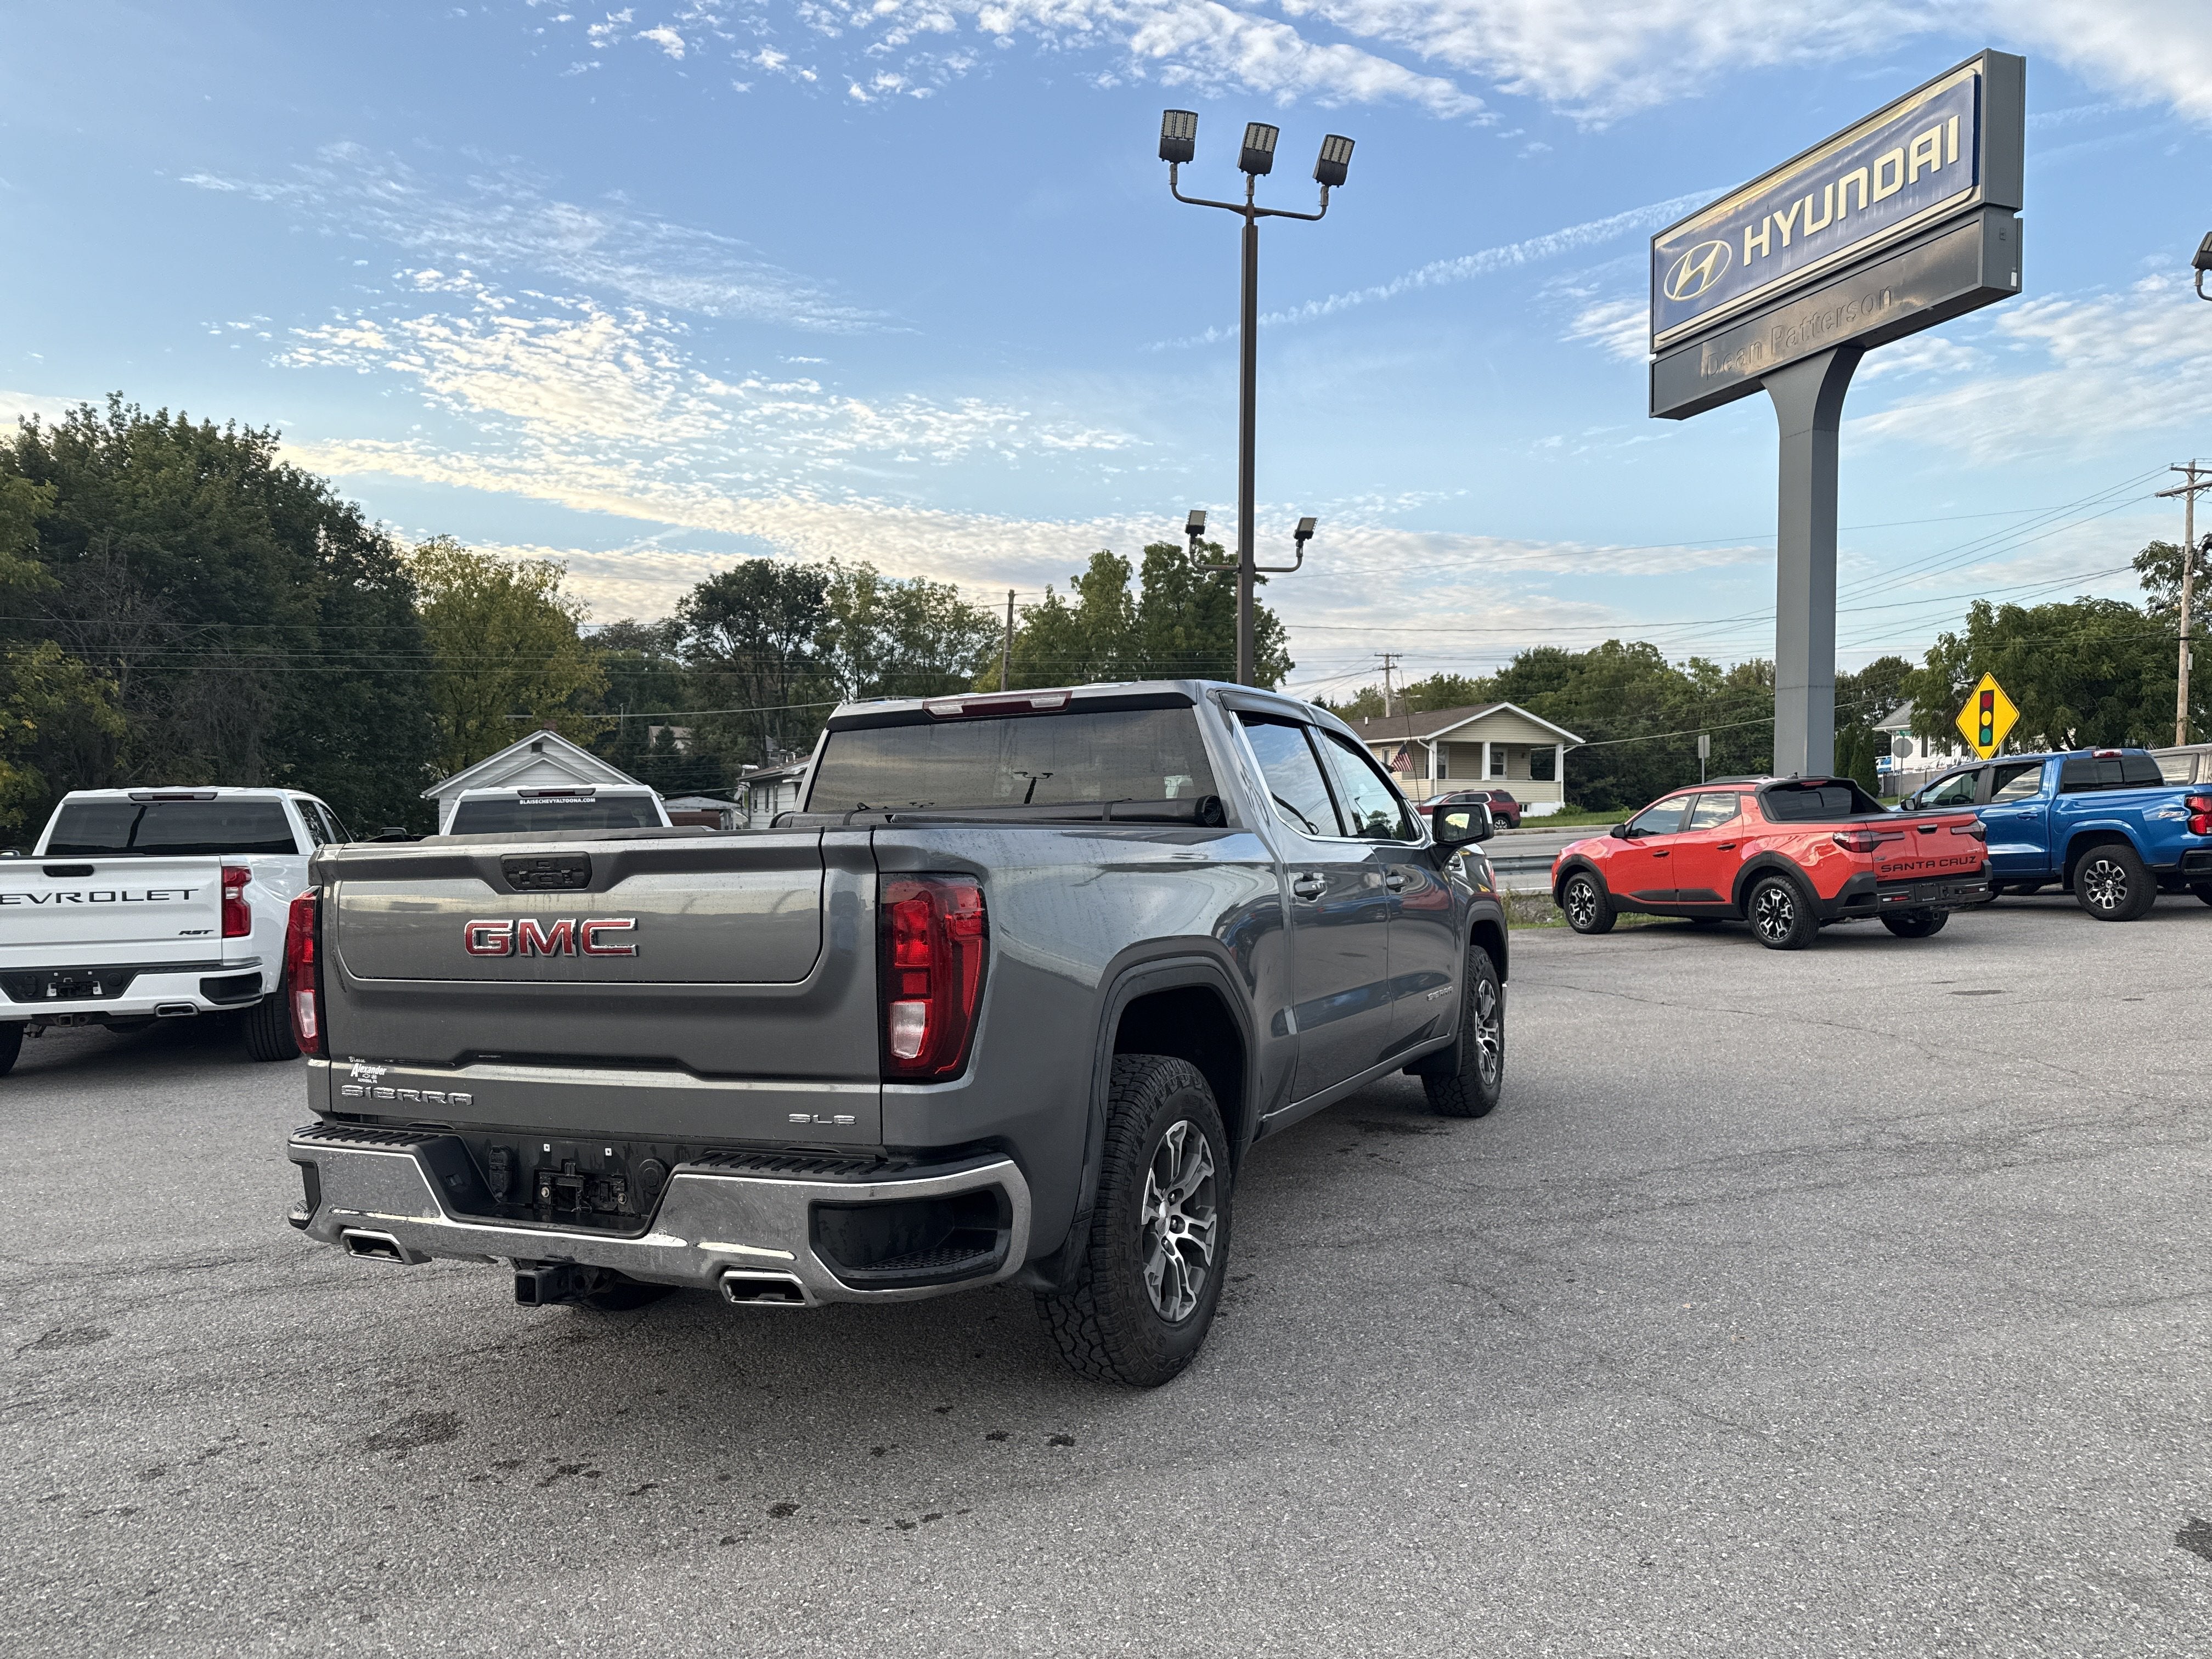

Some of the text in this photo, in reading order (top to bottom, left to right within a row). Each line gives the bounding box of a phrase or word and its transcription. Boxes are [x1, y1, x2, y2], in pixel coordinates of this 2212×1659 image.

[1743, 115, 1960, 267] HYUNDAI
[1706, 285, 1894, 380] Dean Patterson
[1881, 856, 1977, 873] SANTA CRUZ
[464, 918, 638, 957] GMC
[1426, 986, 1453, 1001] SIERRA
[350, 1063, 387, 1077] Alexander
[341, 1085, 473, 1106] SIERRA
[788, 1114, 855, 1125] SLE
